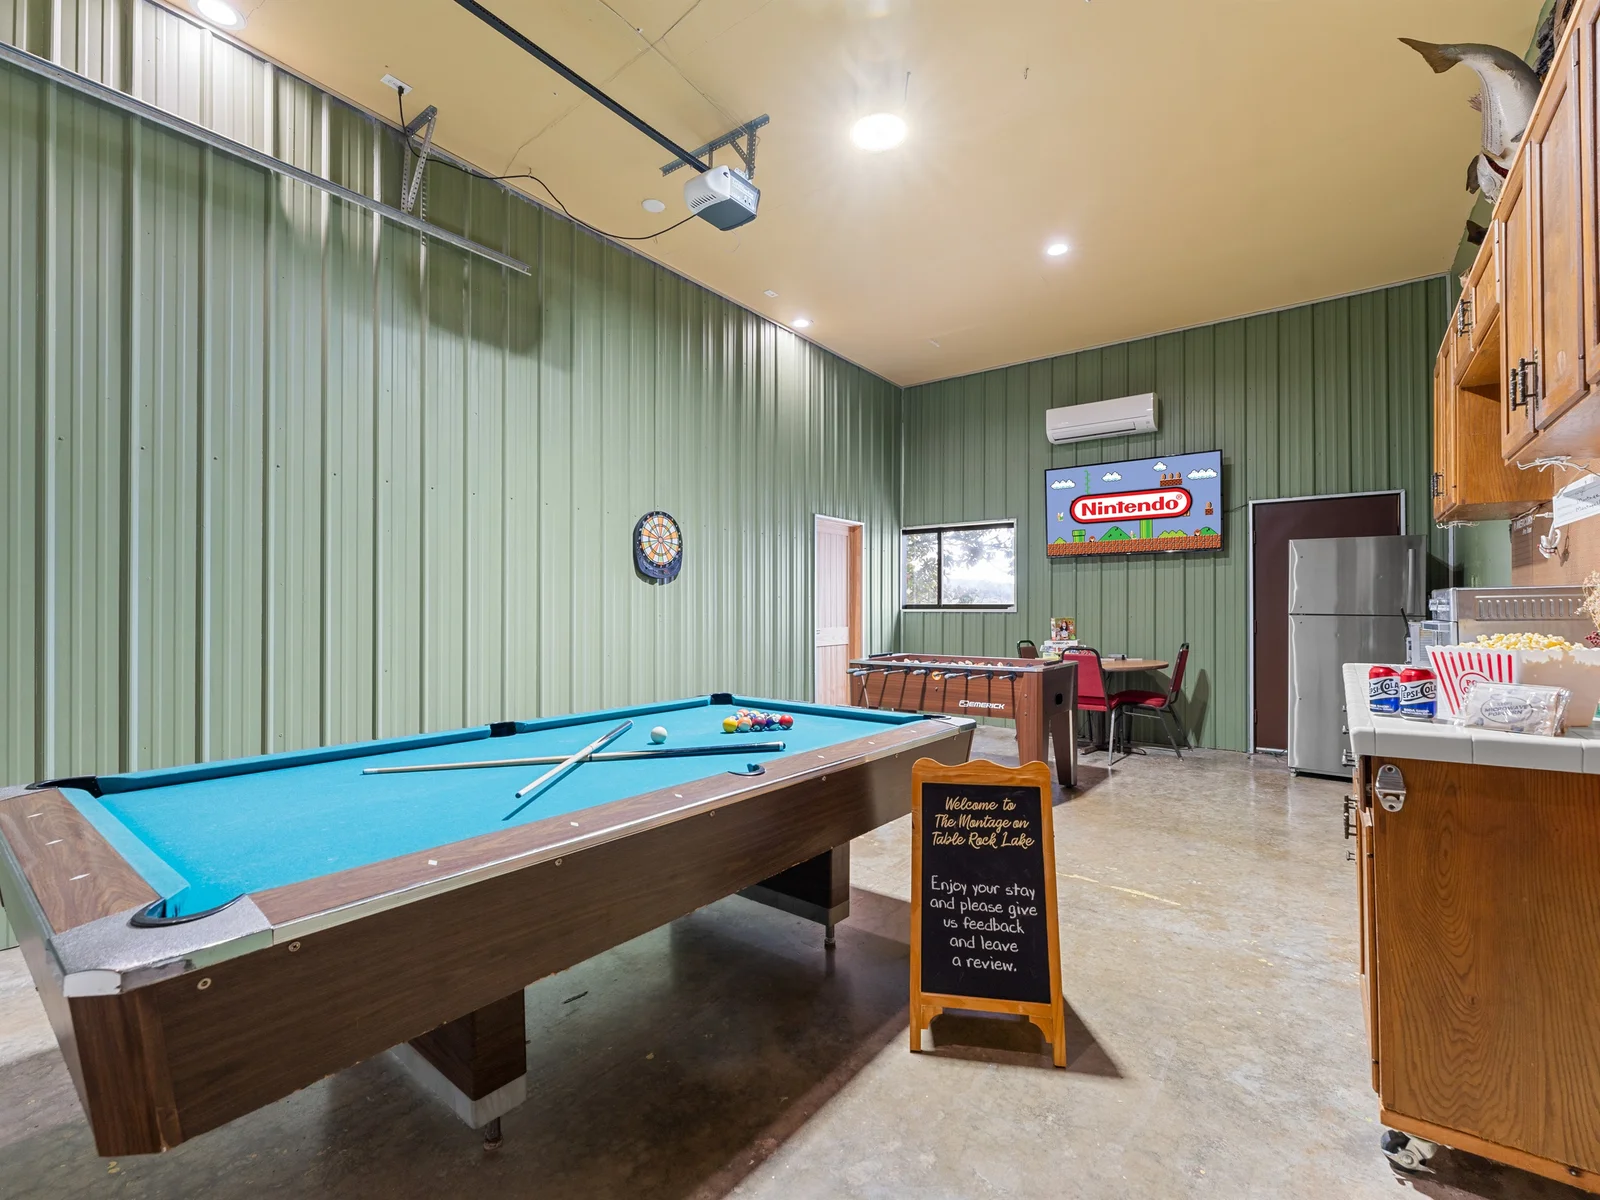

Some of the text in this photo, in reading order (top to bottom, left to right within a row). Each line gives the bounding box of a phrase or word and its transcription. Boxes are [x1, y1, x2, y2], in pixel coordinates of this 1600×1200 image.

[1082, 496, 1179, 516] Nintendo
[1369, 678, 1399, 698] PSI-COLA
[945, 796, 1017, 811] Welcome to
[934, 813, 1030, 834] The Montage on
[931, 831, 1035, 849] Table Rock Lake
[931, 875, 1036, 898] Enjoy your stay
[929, 897, 1038, 919] and please give
[943, 917, 1025, 934] us feedback
[949, 935, 1019, 953] and leave
[952, 956, 1018, 973] a review.
